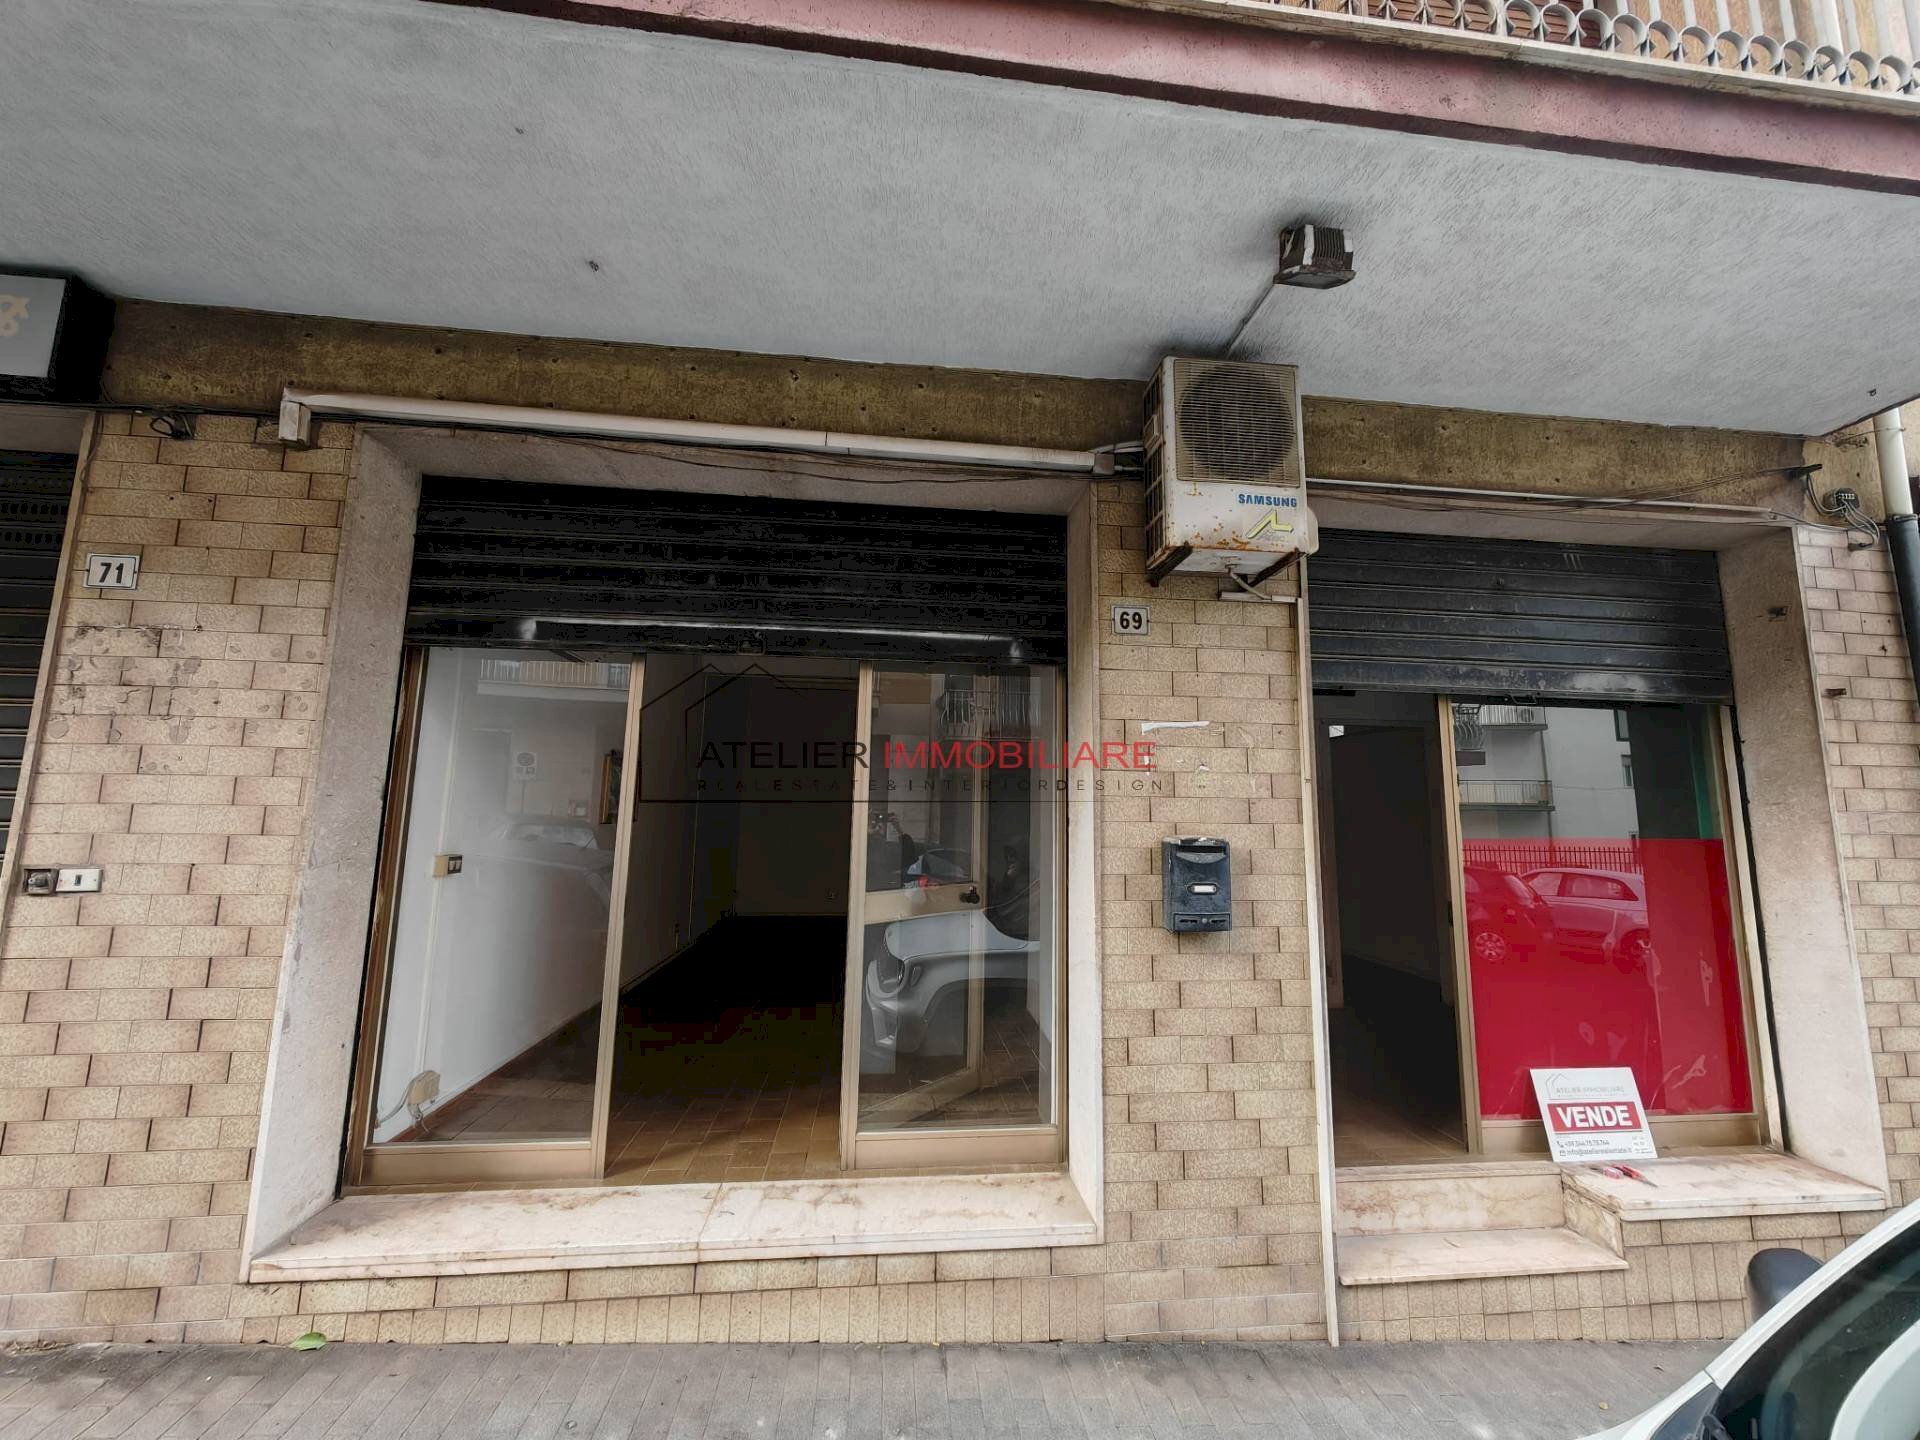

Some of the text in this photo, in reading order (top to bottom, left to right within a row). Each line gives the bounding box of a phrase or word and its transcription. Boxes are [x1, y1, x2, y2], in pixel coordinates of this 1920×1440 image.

[1238, 493, 1297, 508] SAMSUNG
[99, 562, 124, 583] 71
[1120, 611, 1142, 630] 69
[1556, 1105, 1633, 1128] VENDE
